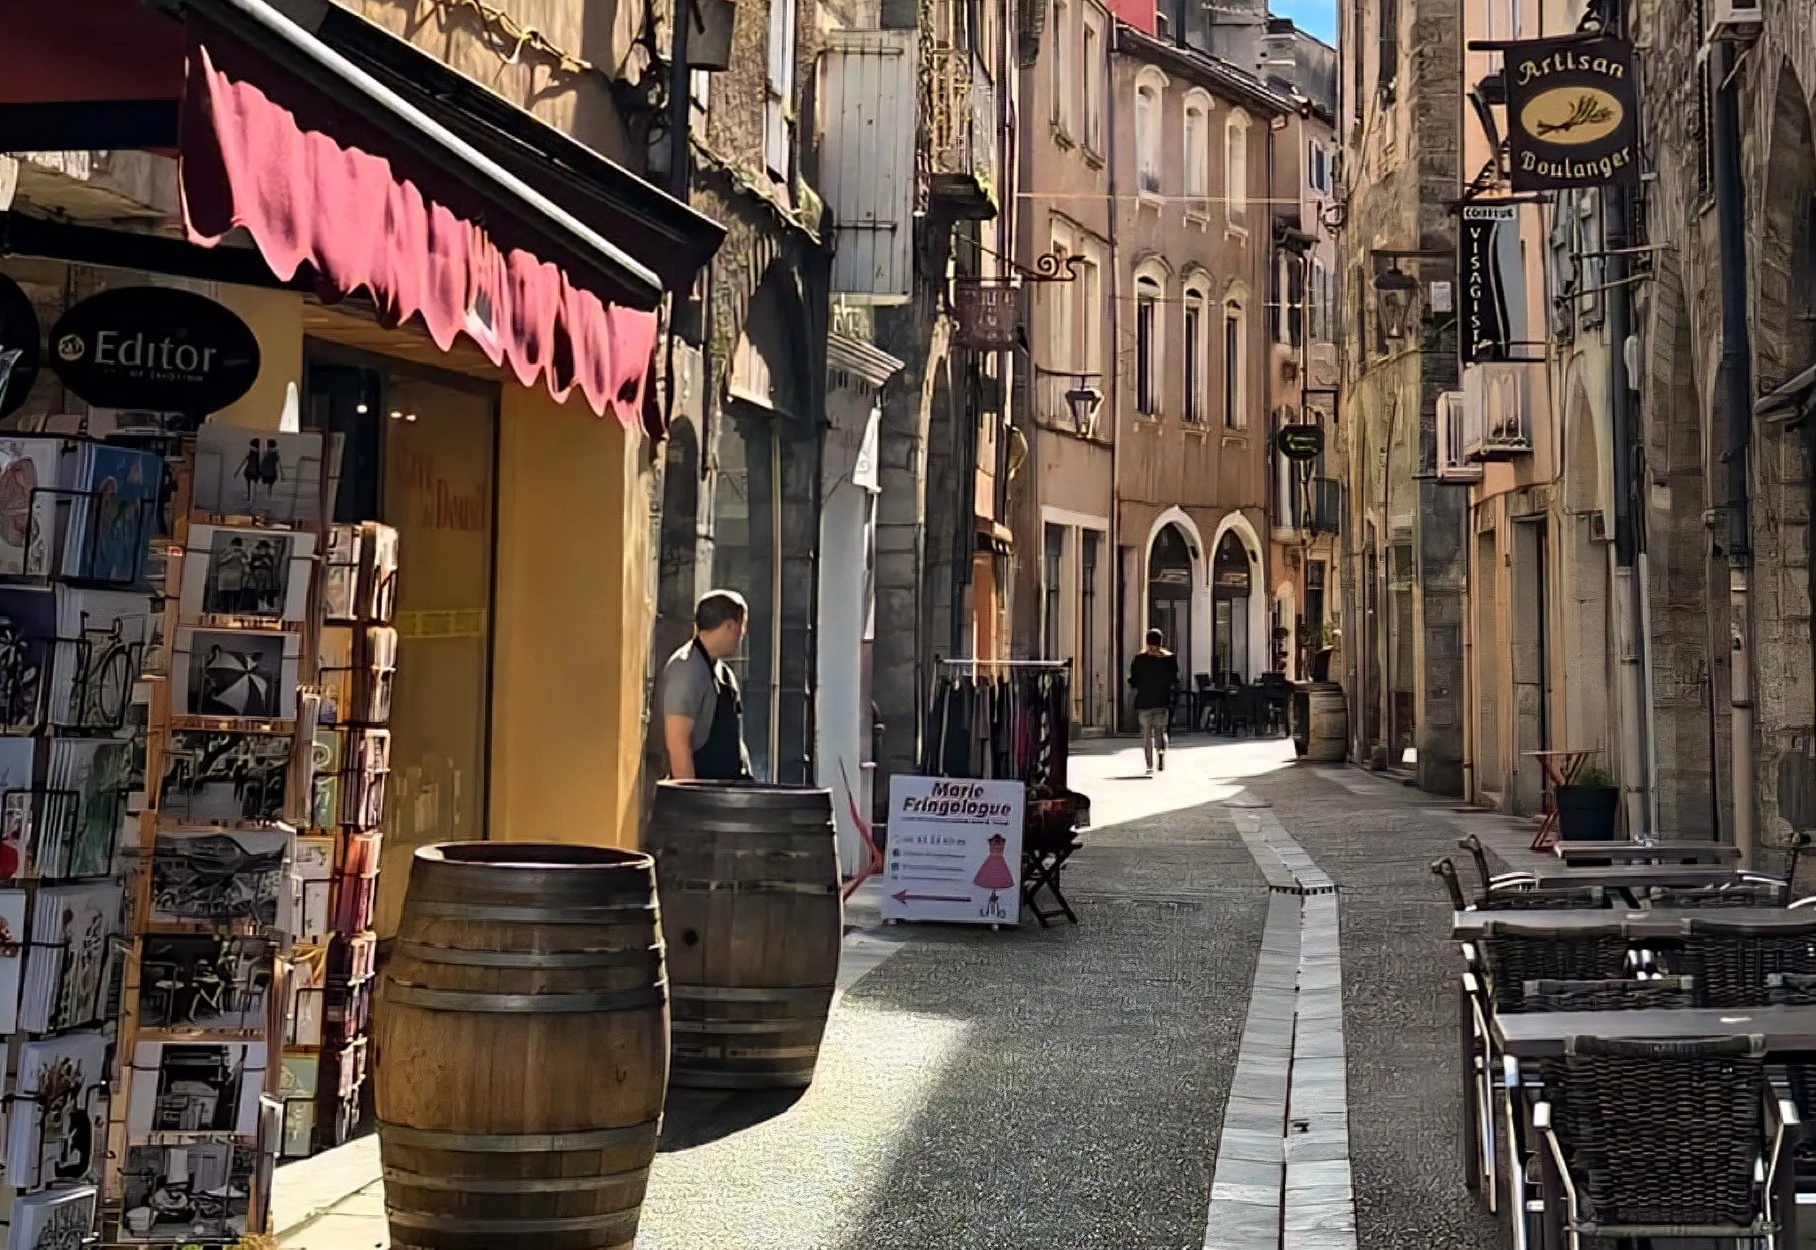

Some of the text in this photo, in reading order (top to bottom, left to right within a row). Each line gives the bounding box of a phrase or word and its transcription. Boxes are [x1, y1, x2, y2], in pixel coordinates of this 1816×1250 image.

[1516, 51, 1624, 86] Artisan
[1520, 144, 1631, 179] Boulanger
[95, 330, 217, 374] Editor
[931, 781, 984, 798] Marie
